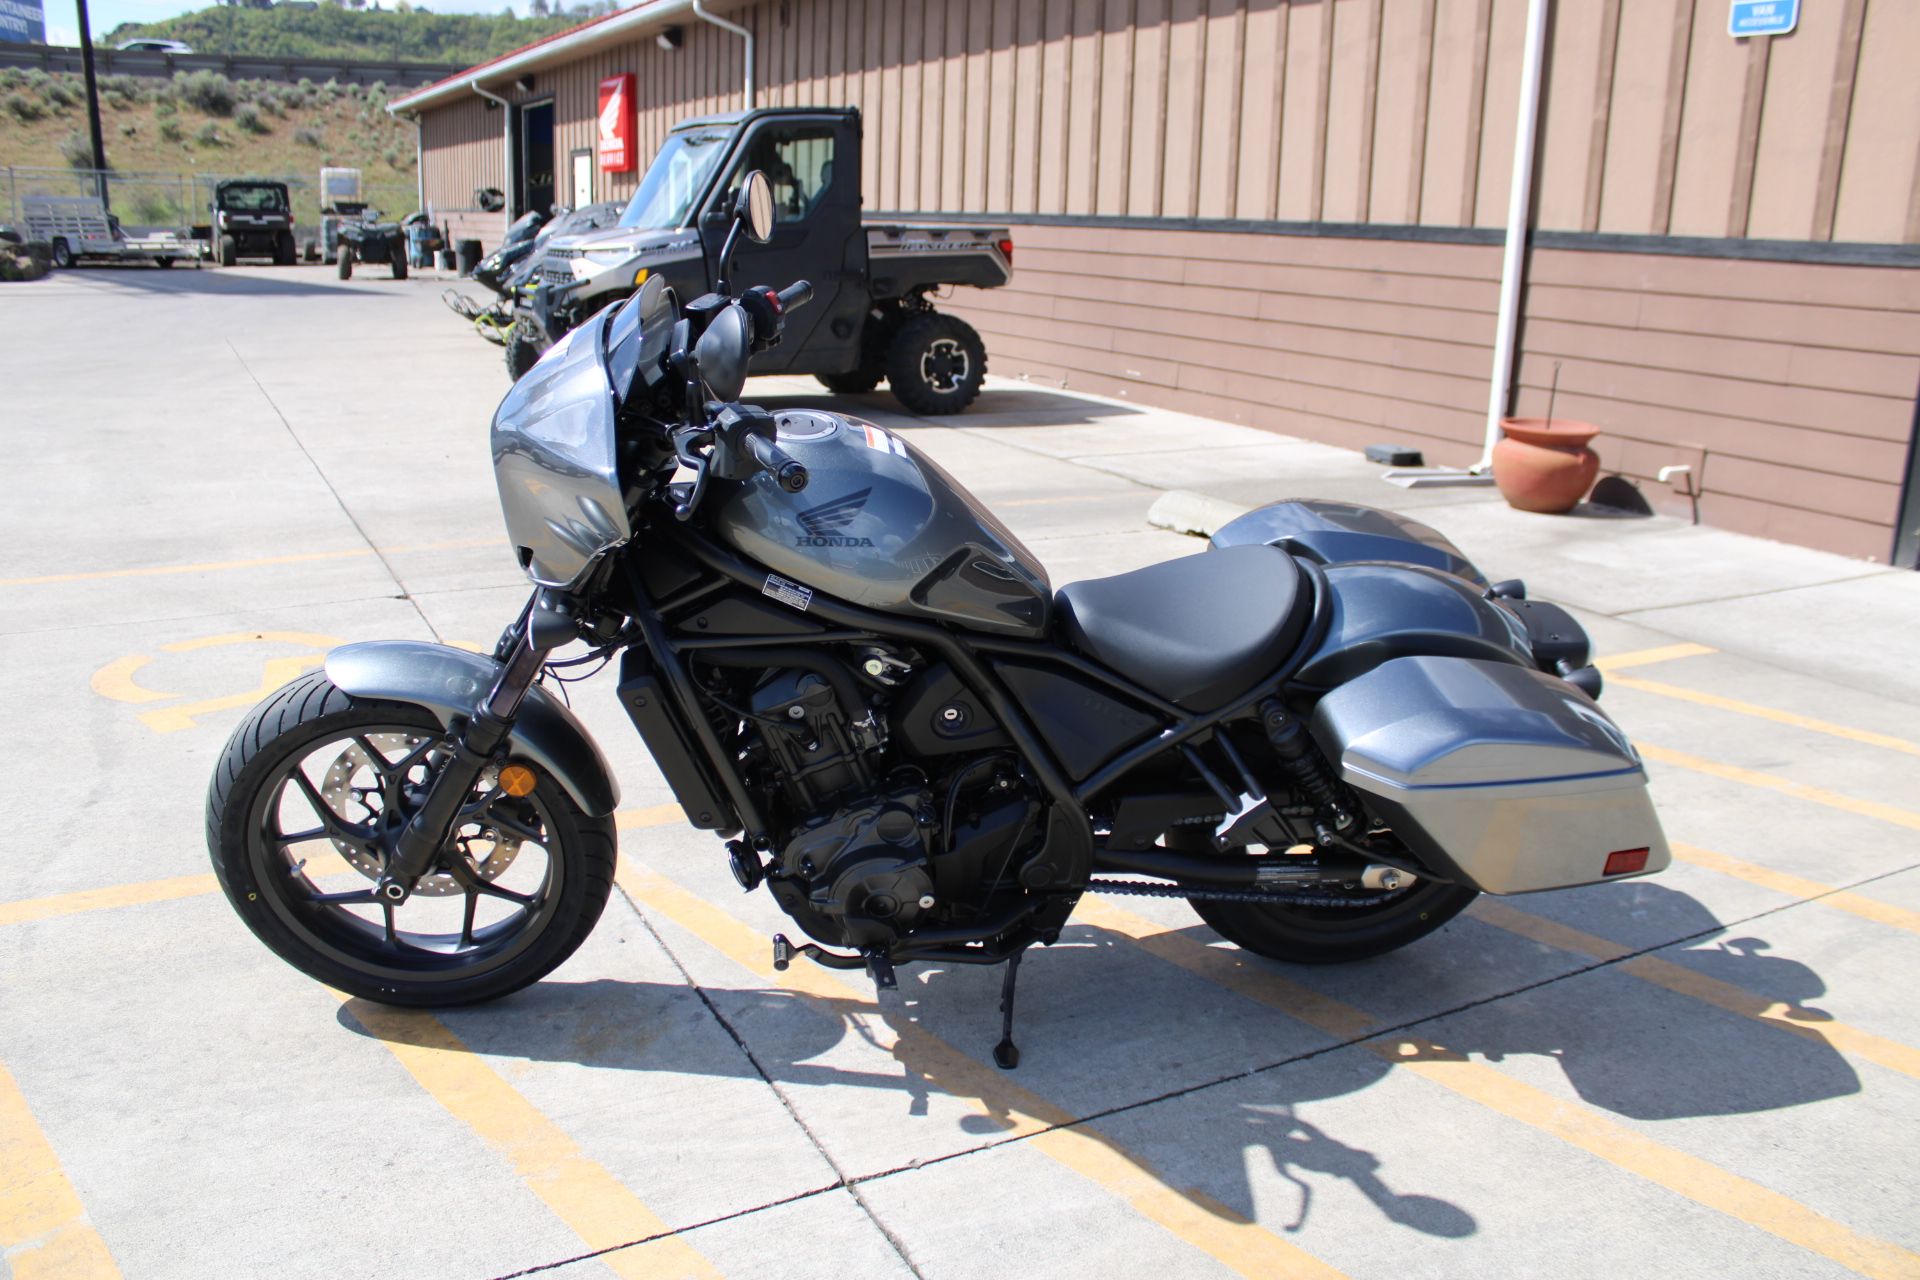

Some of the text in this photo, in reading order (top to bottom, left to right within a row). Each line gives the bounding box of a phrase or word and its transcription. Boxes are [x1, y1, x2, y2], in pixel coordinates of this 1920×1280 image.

[1751, 4, 1777, 16] VAN
[600, 151, 625, 167] SERVICE
[795, 536, 876, 548] HONDA
